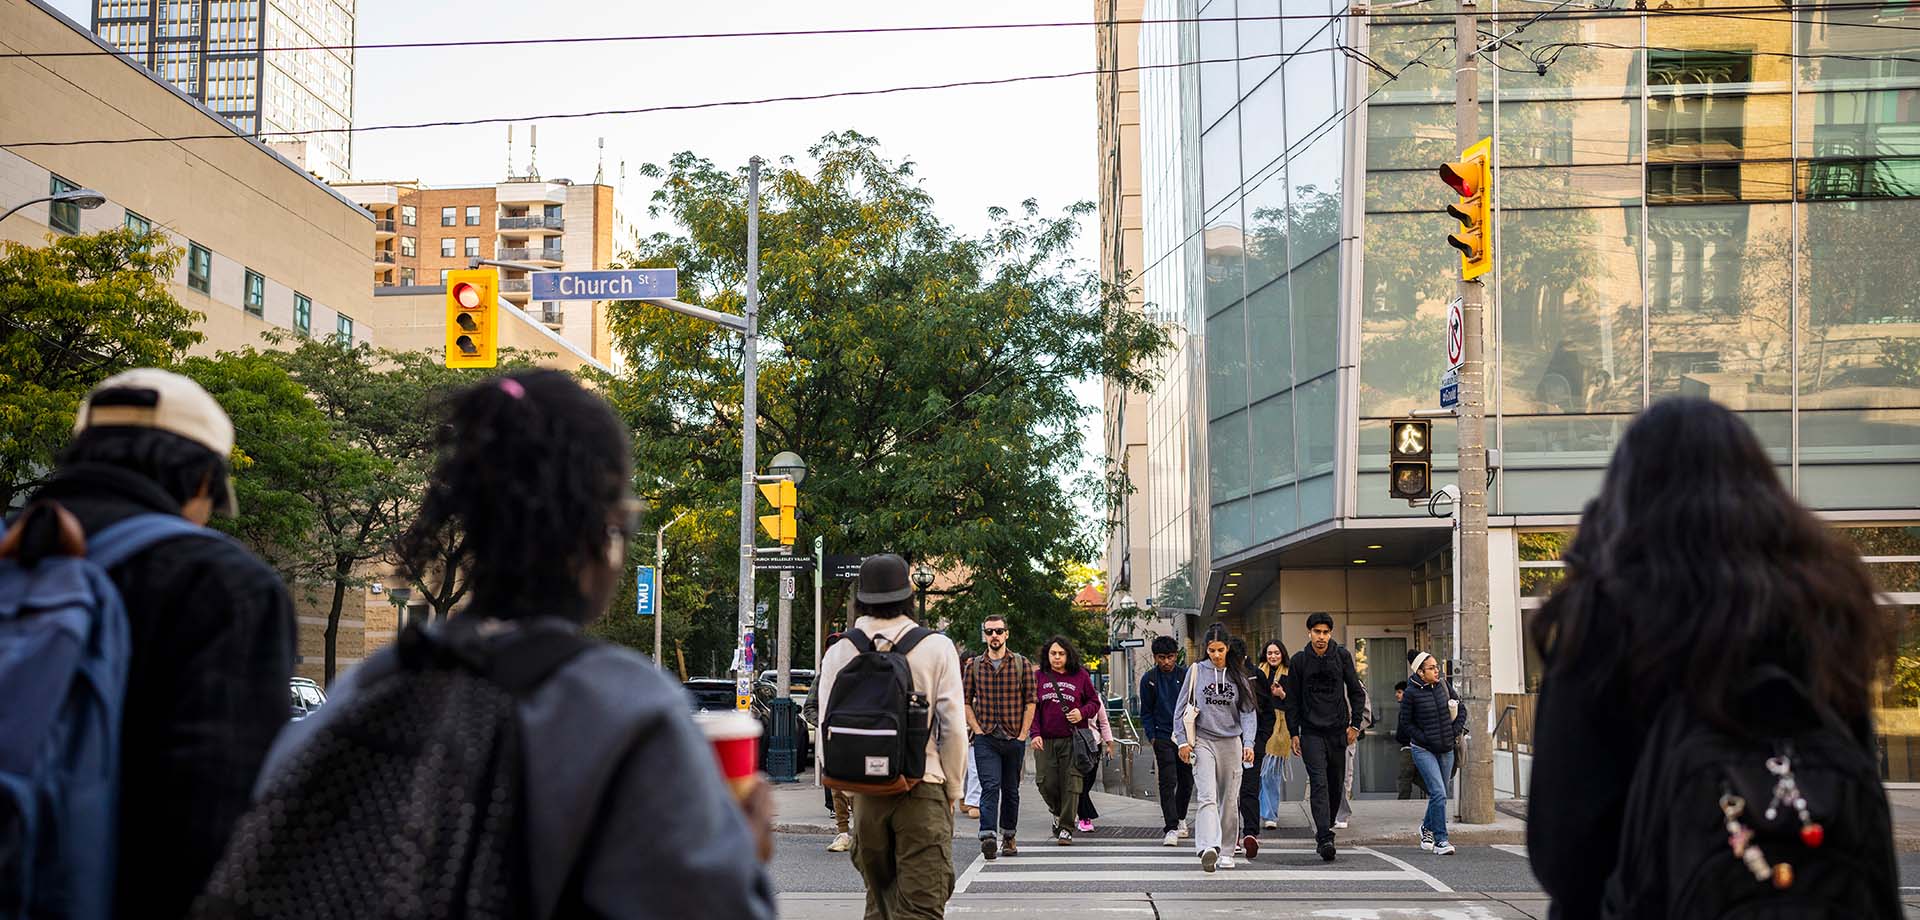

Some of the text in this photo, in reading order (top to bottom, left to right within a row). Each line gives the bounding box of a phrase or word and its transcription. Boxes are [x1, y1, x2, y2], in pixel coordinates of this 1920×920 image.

[559, 274, 649, 296] Church St
[638, 583, 649, 612] TMU
[1205, 697, 1231, 706] Roots
